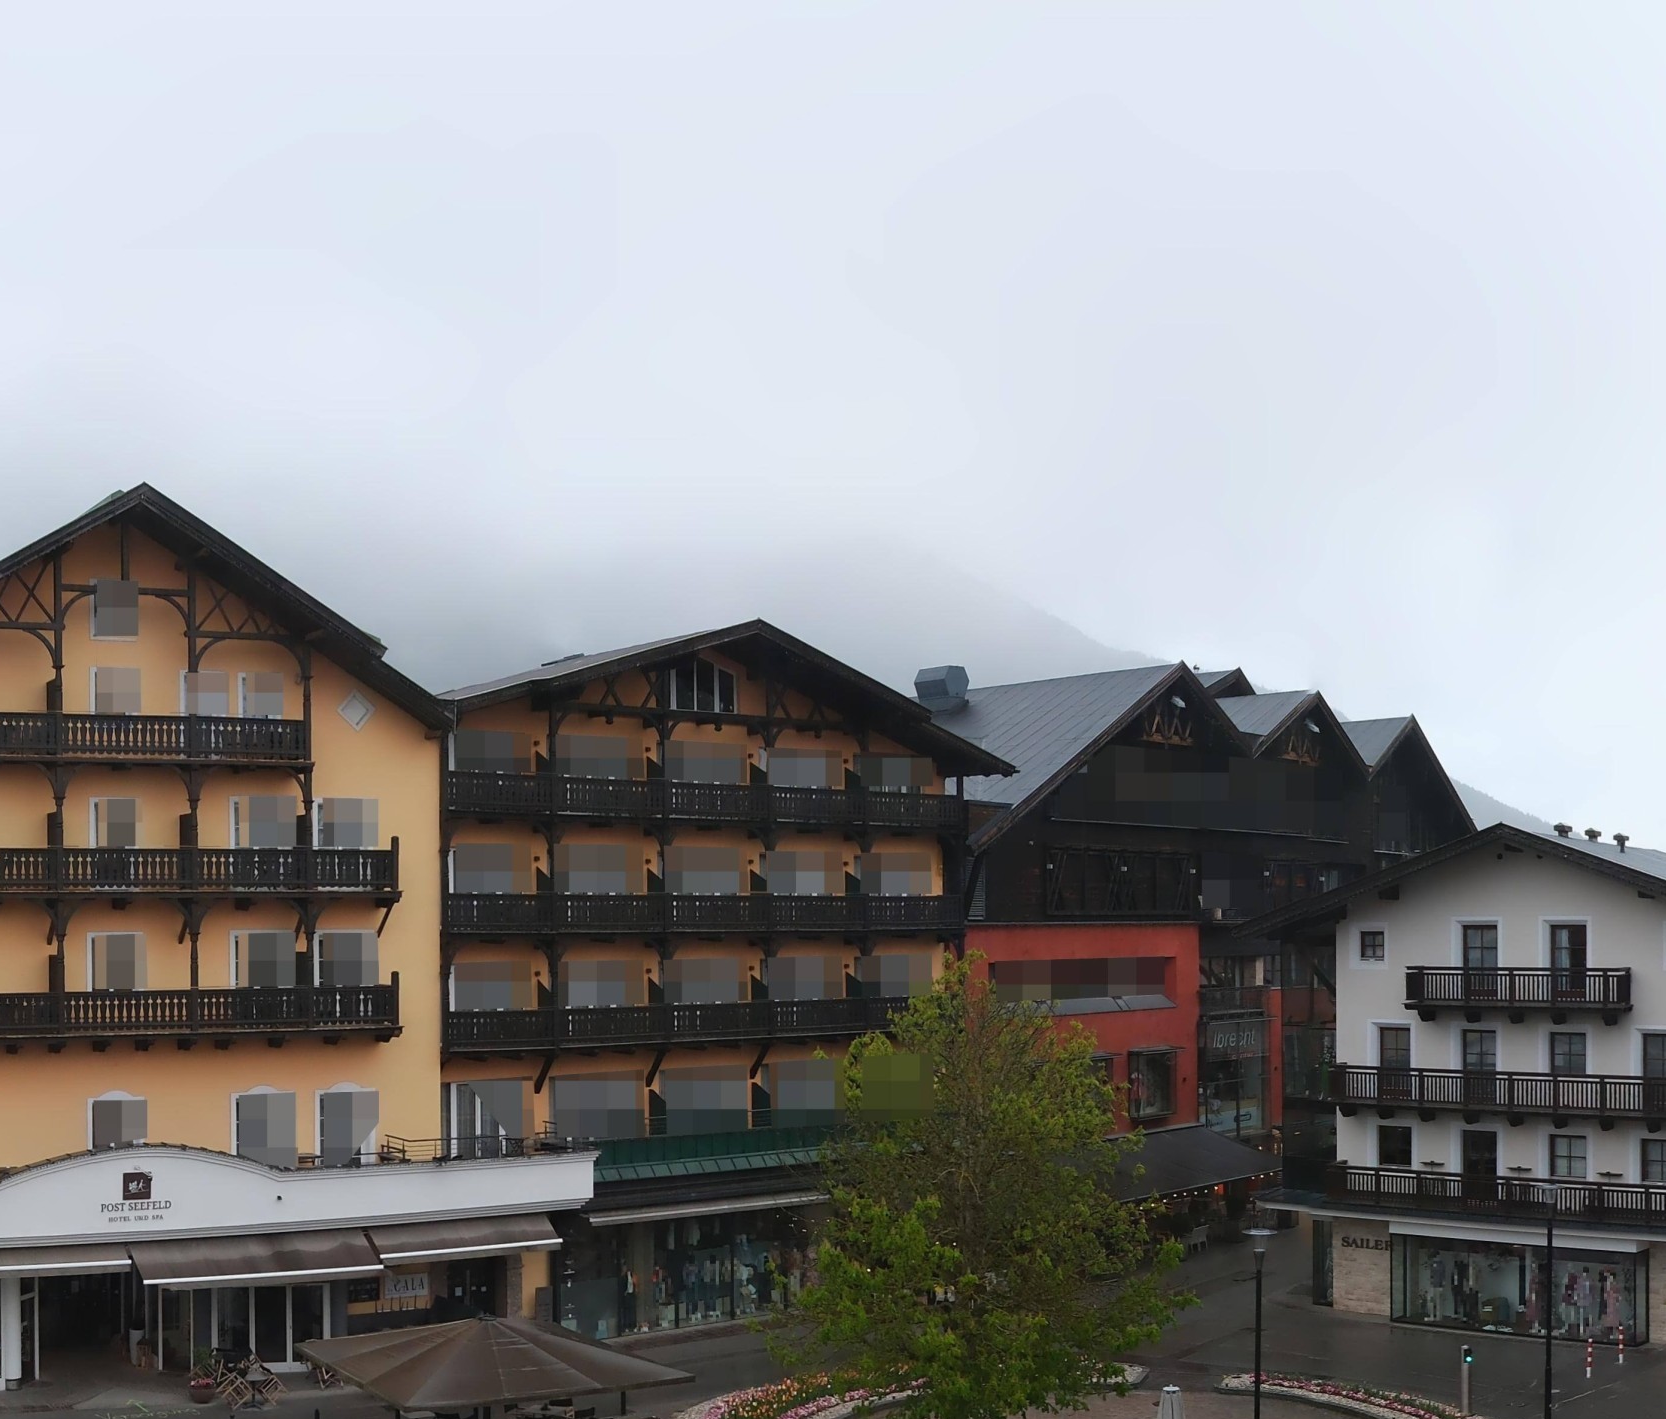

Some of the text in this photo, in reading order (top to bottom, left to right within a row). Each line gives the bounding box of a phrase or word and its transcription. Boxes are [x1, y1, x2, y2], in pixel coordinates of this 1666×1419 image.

[101, 1200, 172, 1213] POST SEEFELD
[108, 1215, 131, 1223] HOTEL
